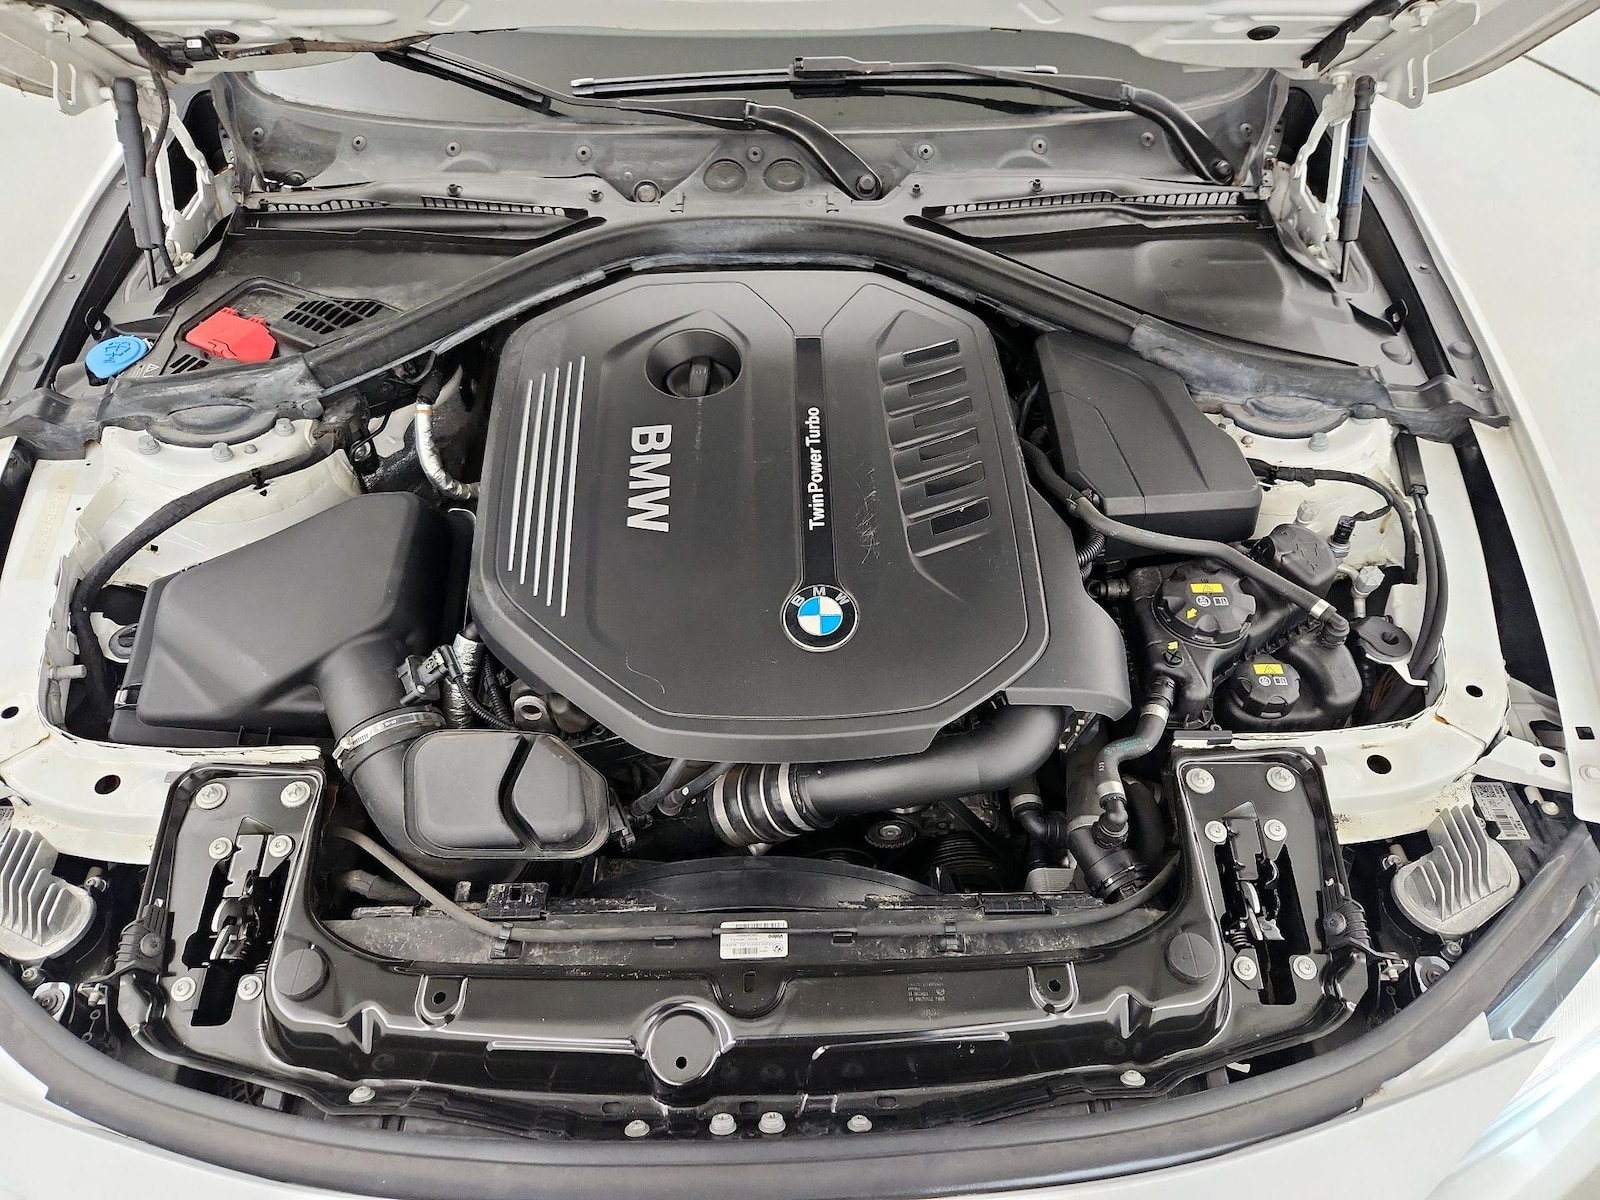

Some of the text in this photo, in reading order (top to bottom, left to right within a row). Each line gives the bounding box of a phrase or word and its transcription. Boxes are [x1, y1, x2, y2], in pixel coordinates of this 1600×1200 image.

[804, 406, 821, 447] Turbo
[626, 424, 672, 532] BMW
[790, 586, 850, 608] BMW
